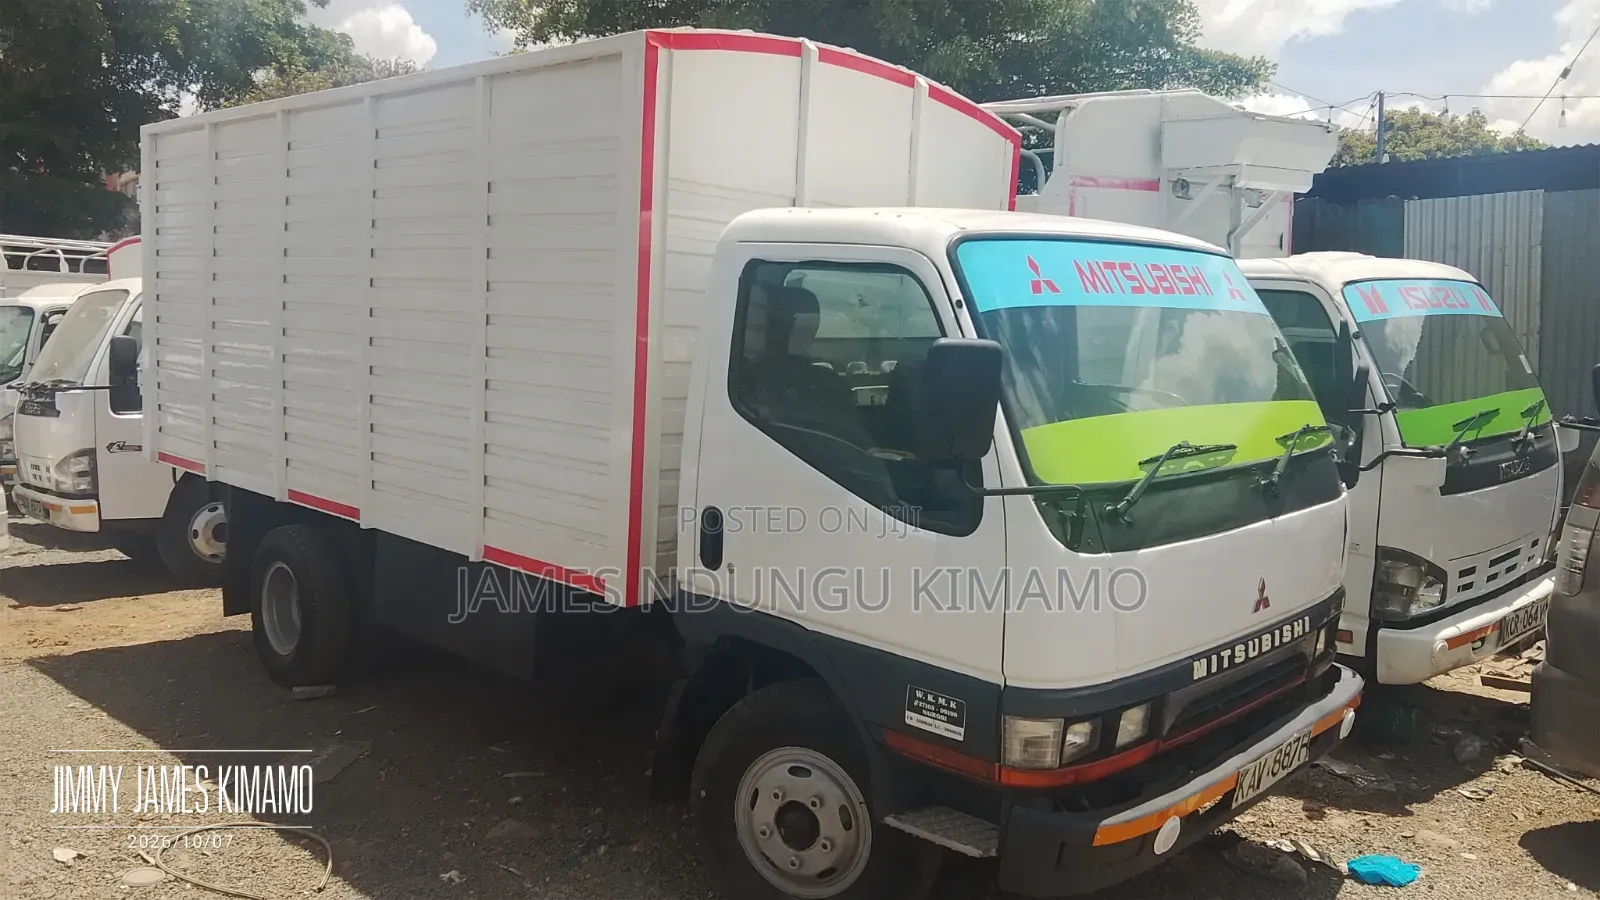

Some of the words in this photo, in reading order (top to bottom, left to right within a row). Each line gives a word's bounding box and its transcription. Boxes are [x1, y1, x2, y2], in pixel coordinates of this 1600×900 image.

[1073, 259, 1214, 296] MITSUBISHI
[1396, 286, 1470, 309] ISUZU
[1193, 616, 1310, 680] MITSUBISHI
[916, 690, 926, 700] W.
[950, 700, 957, 709] K
[922, 709, 948, 722] NAIROBI
[1235, 757, 1268, 803] KAV
[1271, 731, 1312, 778] 887H
